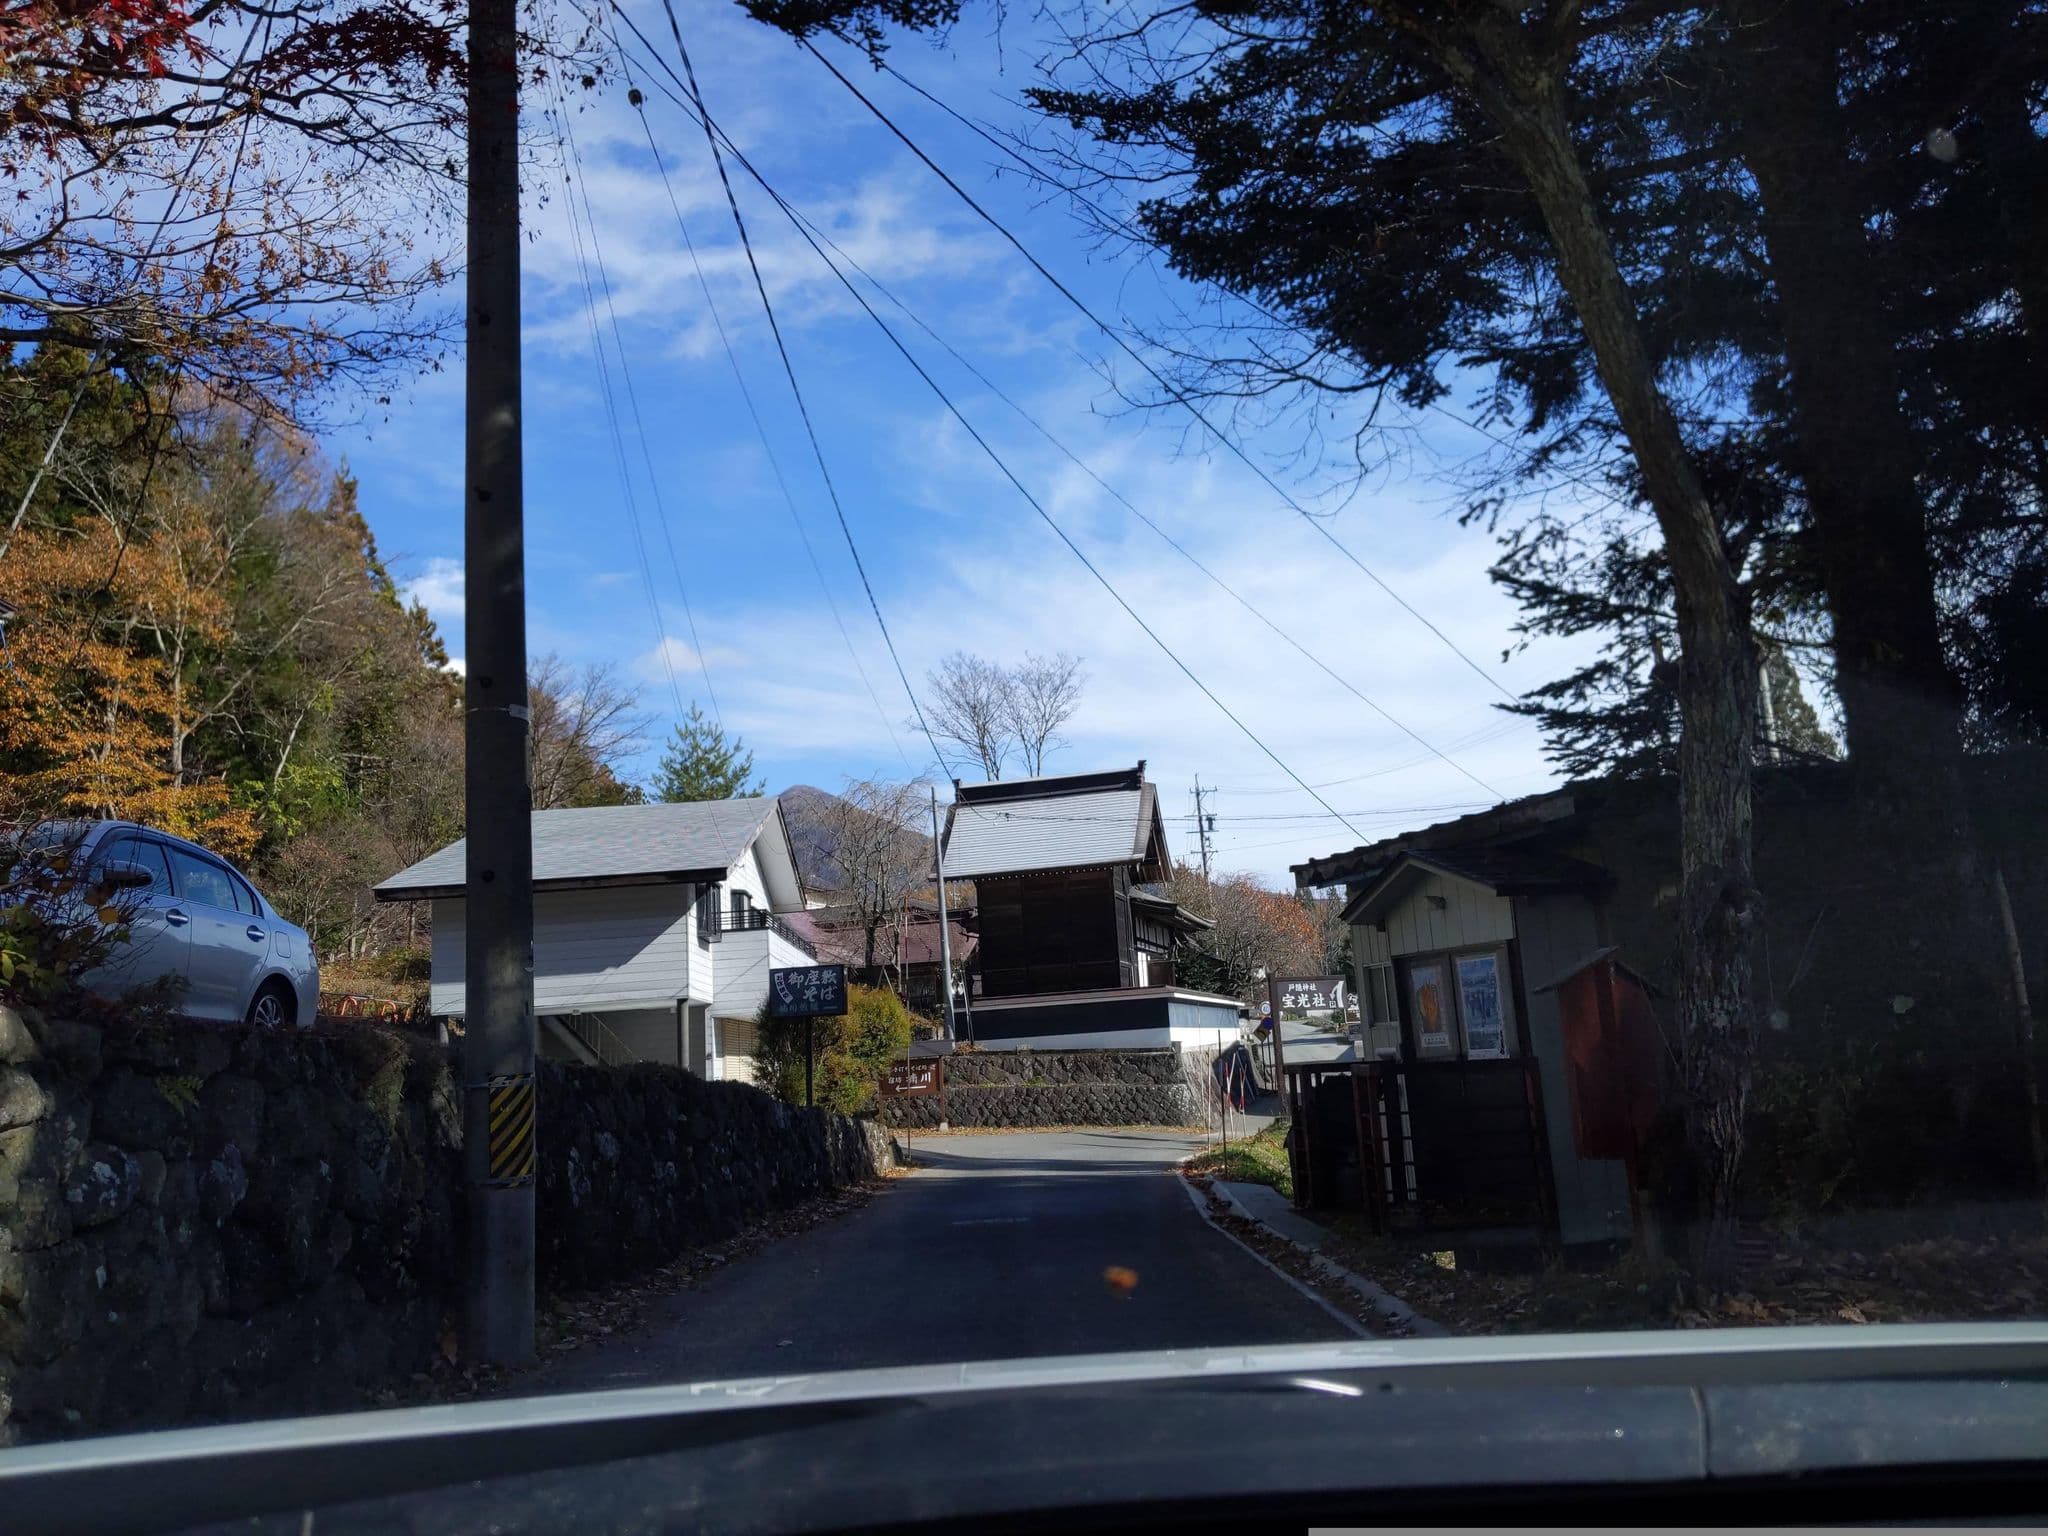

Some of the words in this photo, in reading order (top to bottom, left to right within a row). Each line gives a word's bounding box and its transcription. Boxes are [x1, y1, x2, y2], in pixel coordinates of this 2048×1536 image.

[788, 969, 837, 989] 御座敷
[803, 985, 838, 1002] そば
[1288, 983, 1317, 992] 戸隠神社
[1282, 993, 1326, 1008] 宝光社
